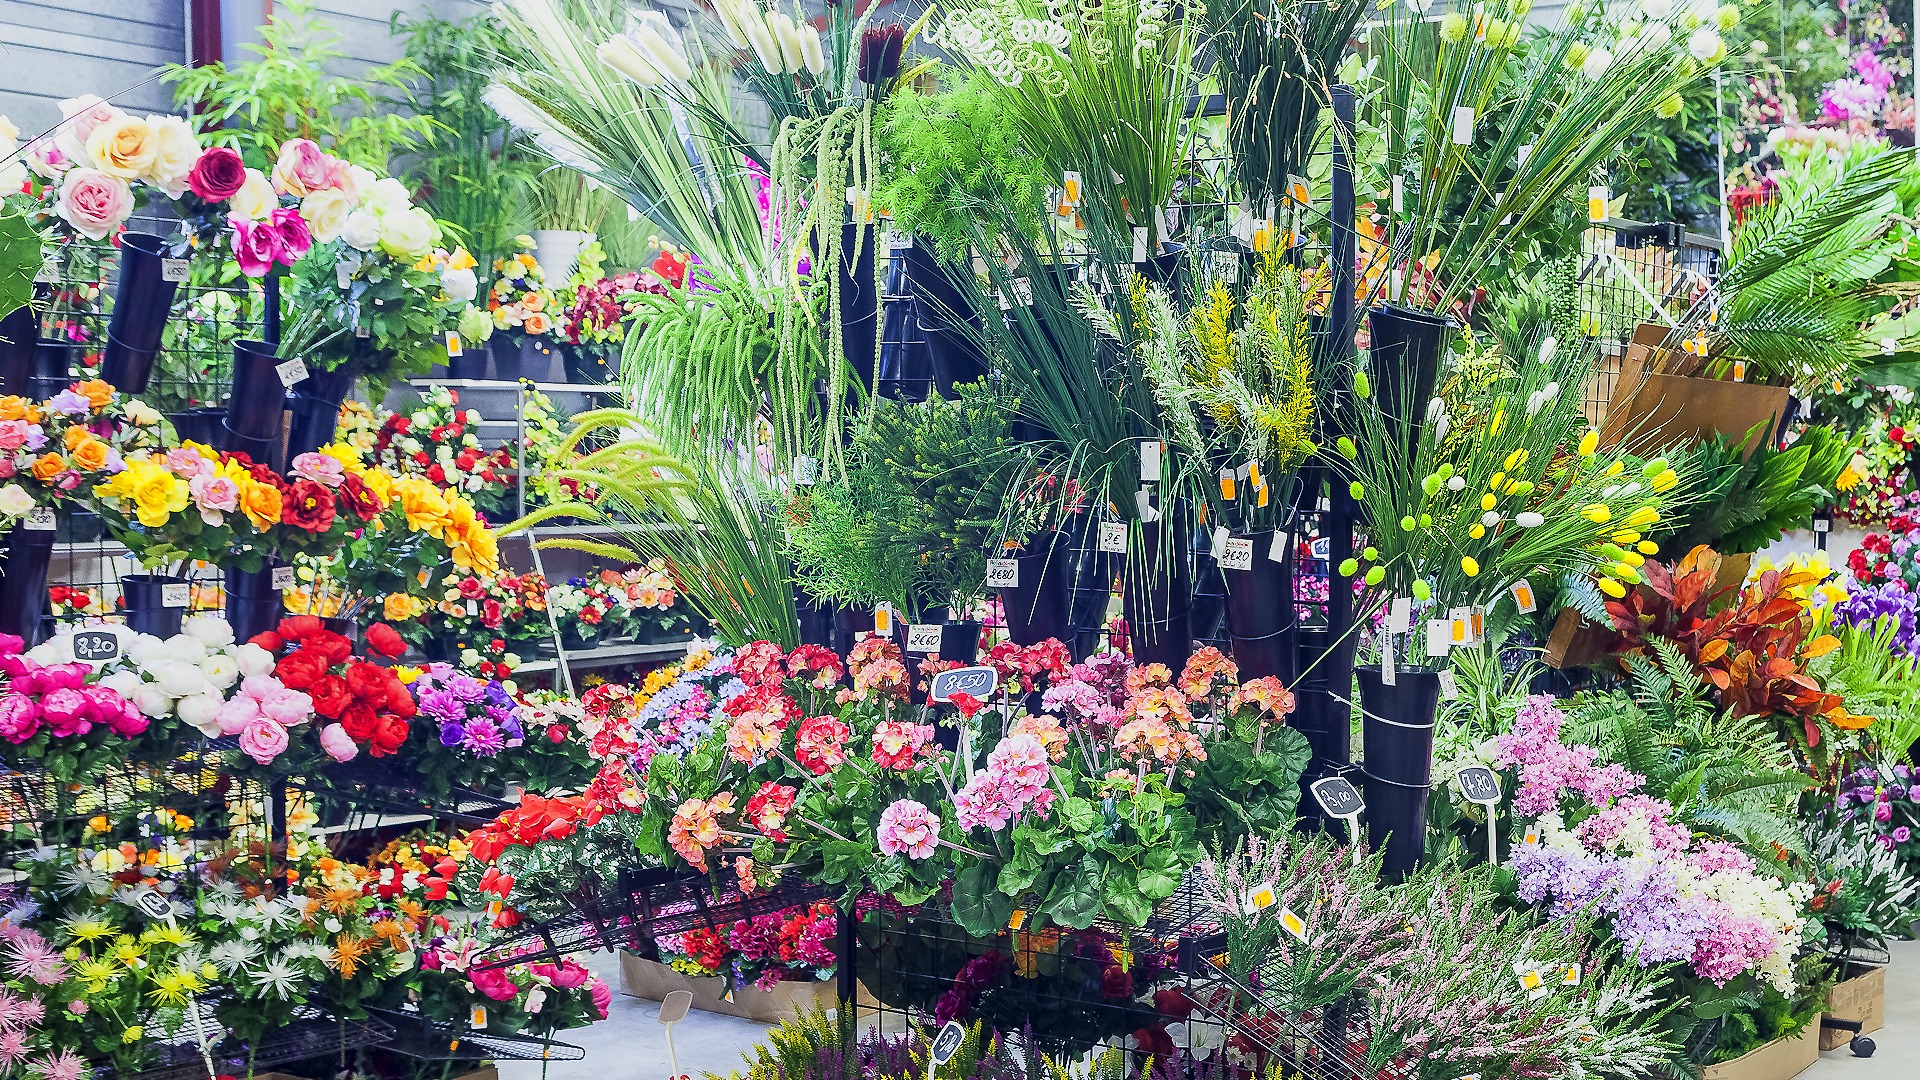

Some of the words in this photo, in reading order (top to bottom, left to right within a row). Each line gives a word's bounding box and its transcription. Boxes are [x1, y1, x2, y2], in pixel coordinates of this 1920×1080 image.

[1222, 548, 1250, 562] 2€20
[989, 568, 1015, 580] 2€80
[76, 636, 115, 659] 8,20
[909, 633, 940, 646] 2€60
[943, 672, 987, 691] 8€50
[1461, 772, 1492, 798] 7,80
